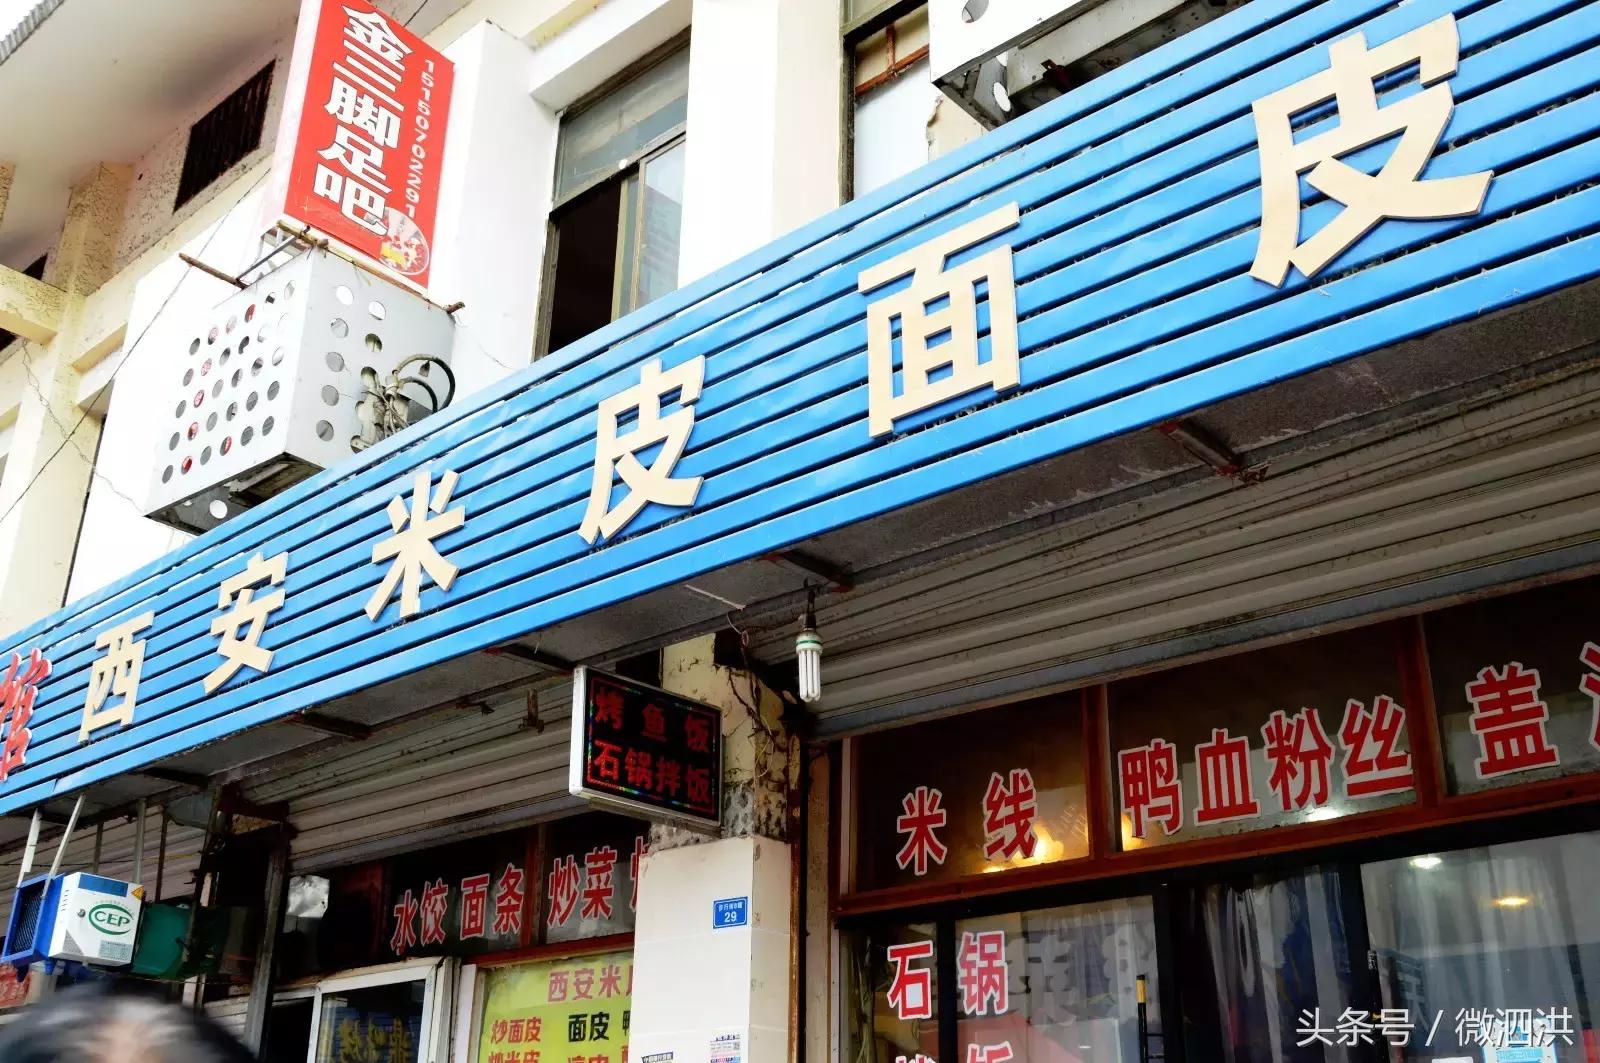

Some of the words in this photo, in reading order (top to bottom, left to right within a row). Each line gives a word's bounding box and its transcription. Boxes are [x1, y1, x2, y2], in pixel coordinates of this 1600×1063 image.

[313, 4, 413, 237] 金三脚足吧
[1465, 641, 1600, 780] 盖
[594, 739, 709, 802] 石锅拌饭
[1118, 694, 1415, 839] 鸭血粉丝
[94, 910, 130, 927] CEP
[724, 911, 737, 923] 29
[548, 964, 633, 1003] 西安米
[490, 1016, 542, 1044] 炒面皮
[568, 1011, 610, 1043] 面皮
